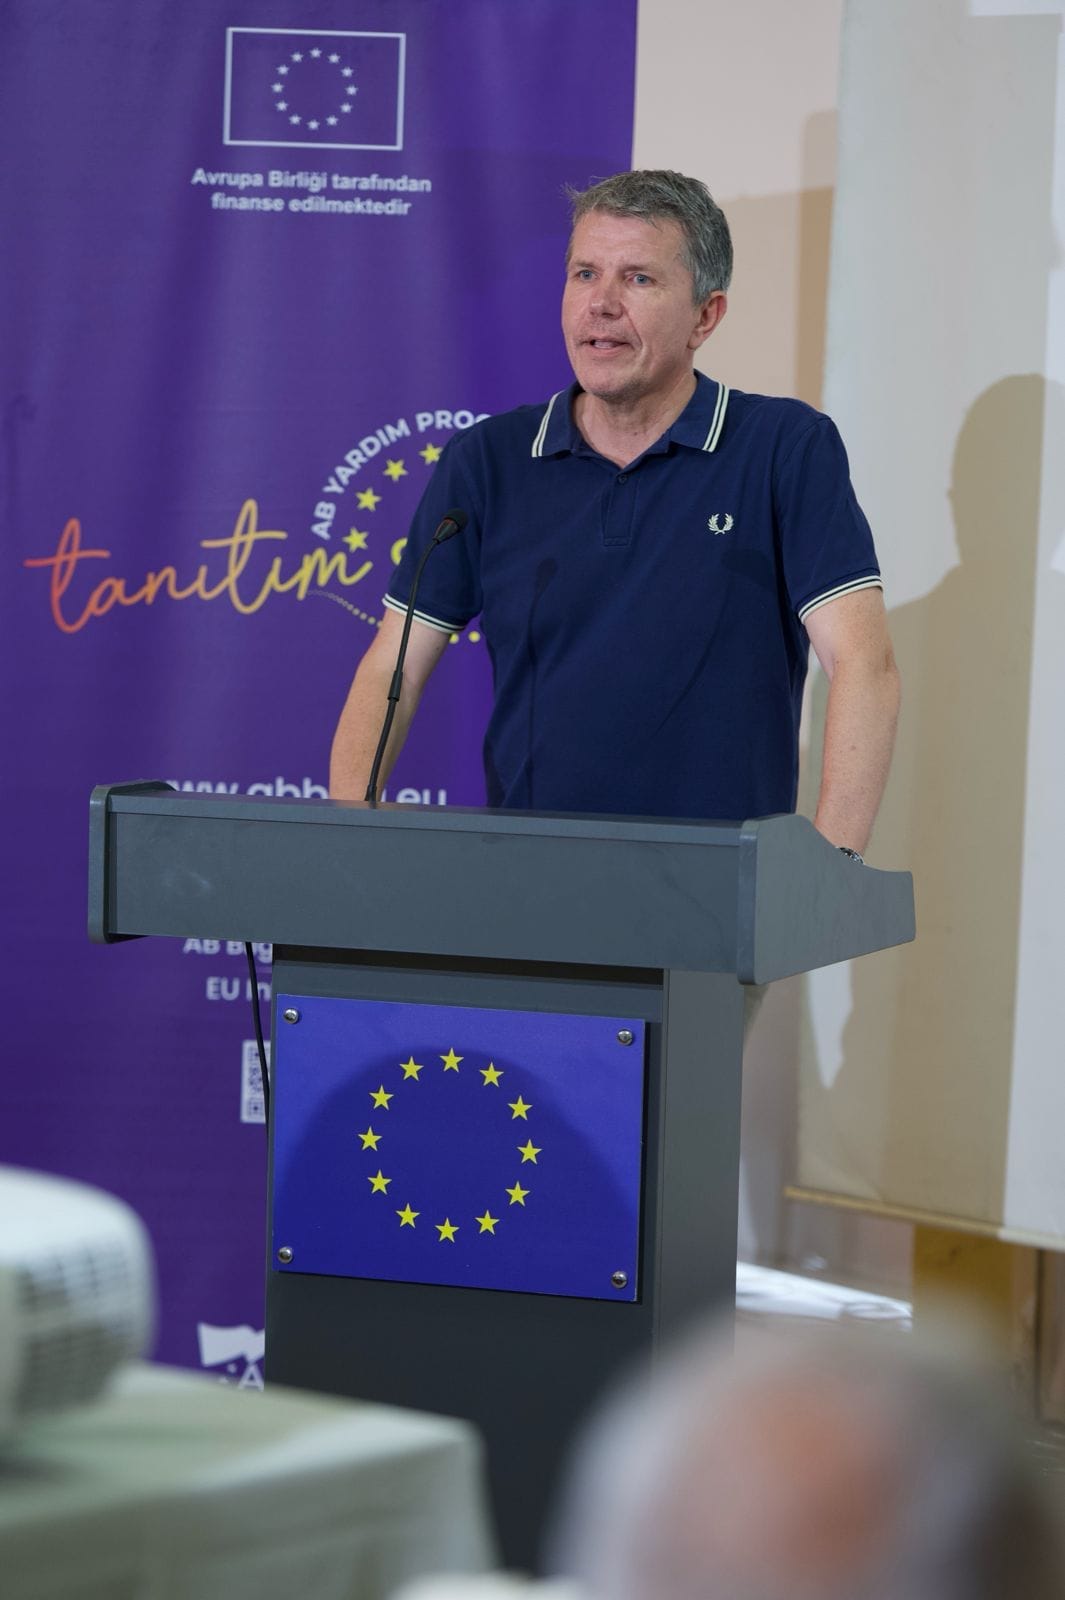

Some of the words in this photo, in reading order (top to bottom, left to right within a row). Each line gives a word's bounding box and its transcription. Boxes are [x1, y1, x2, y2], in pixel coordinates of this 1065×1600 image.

[191, 168, 263, 190] Avrupa
[268, 170, 328, 193] Birliği
[332, 173, 432, 193] tarafından
[211, 192, 284, 212] finanse
[288, 196, 412, 215] edilmektedir
[415, 410, 492, 433] PRO
[322, 418, 411, 495] YARDIM
[311, 501, 337, 541] AB
[183, 938, 220, 955] AB
[206, 976, 240, 1001] EU
